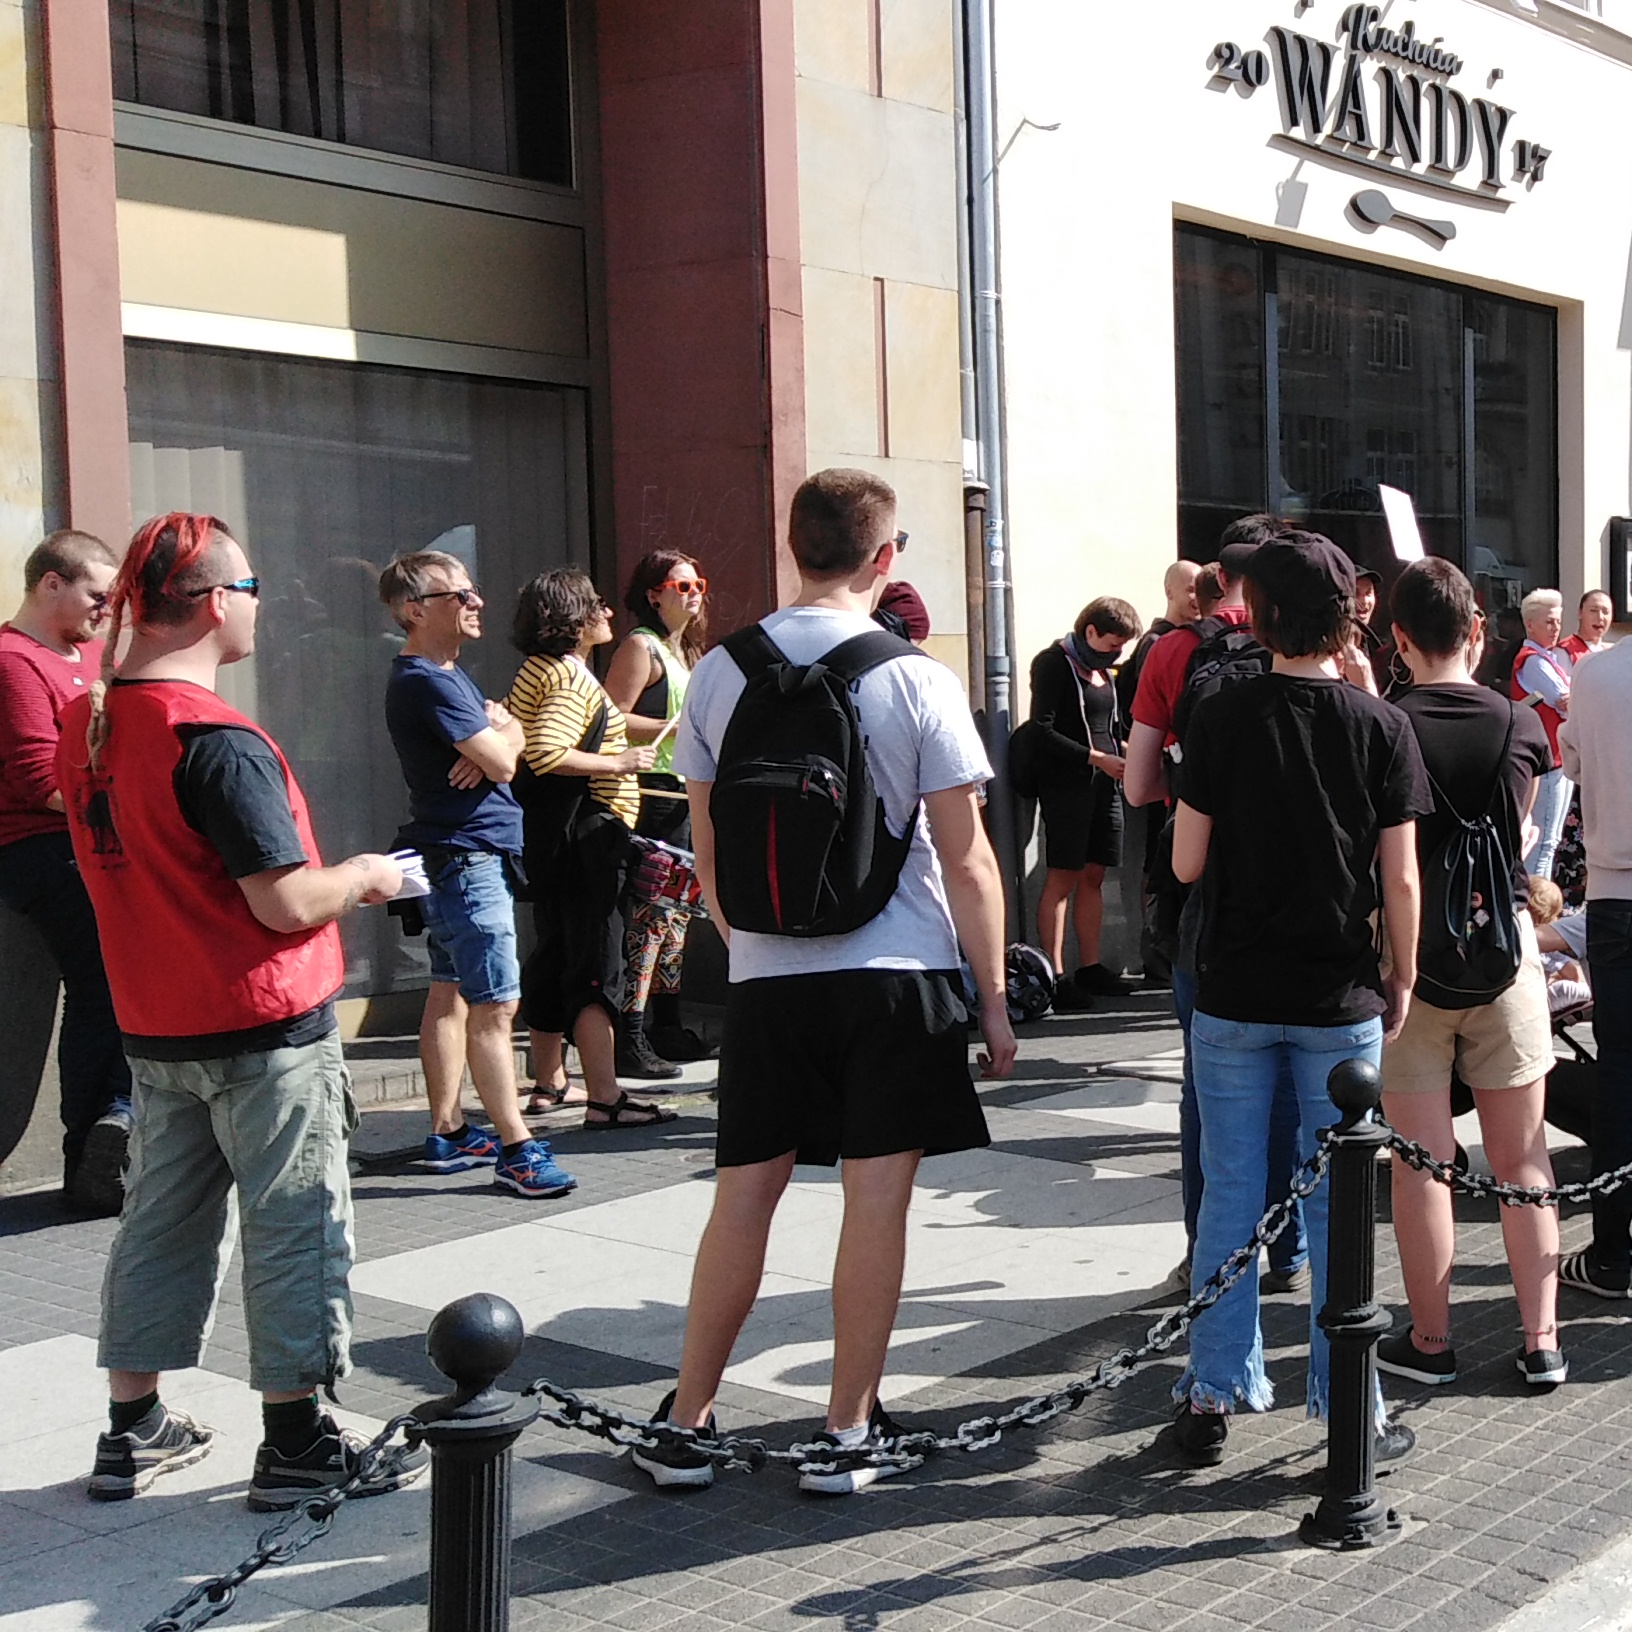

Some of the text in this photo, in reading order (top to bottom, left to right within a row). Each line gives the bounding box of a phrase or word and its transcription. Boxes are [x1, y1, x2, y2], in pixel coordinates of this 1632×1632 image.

[1335, 3, 1464, 76] Kuchnia
[1206, 25, 1552, 190] 20 WANDY 17
